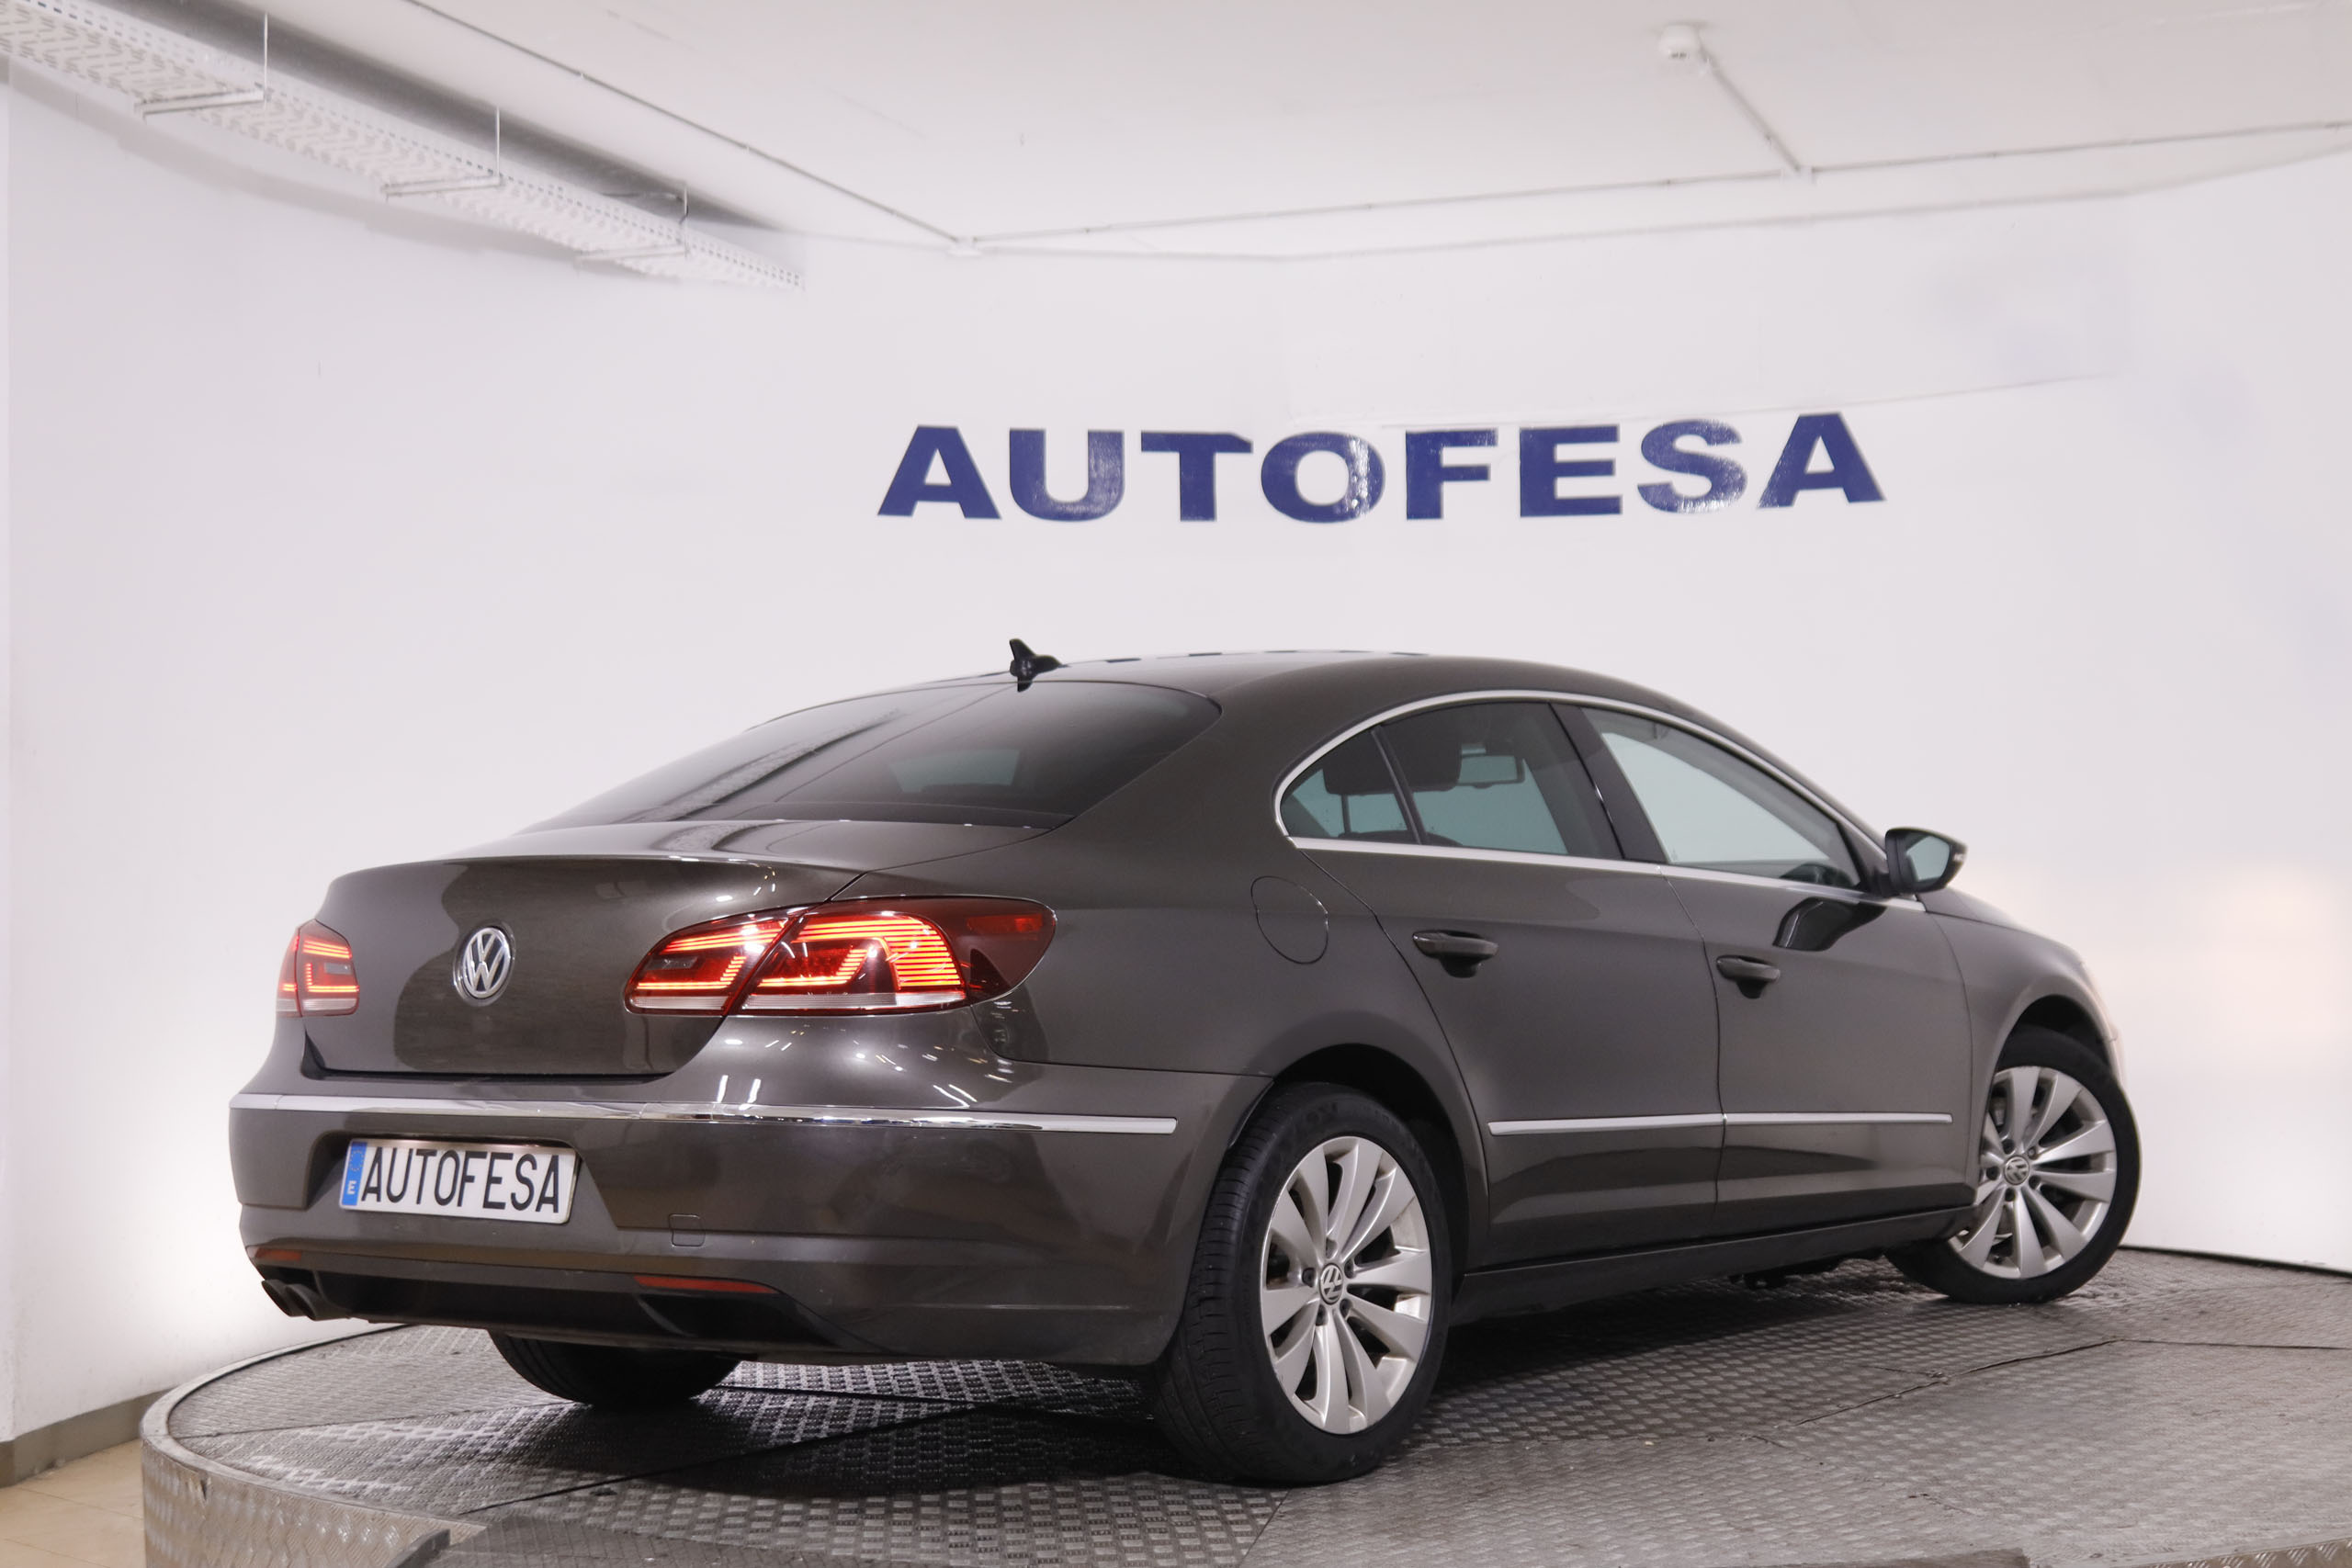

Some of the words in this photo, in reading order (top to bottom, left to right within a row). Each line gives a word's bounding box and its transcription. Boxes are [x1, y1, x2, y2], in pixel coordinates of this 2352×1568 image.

[877, 412, 1885, 523] AUTOFESA
[347, 1180, 356, 1194] E
[361, 1146, 560, 1213] AUTOFESA
